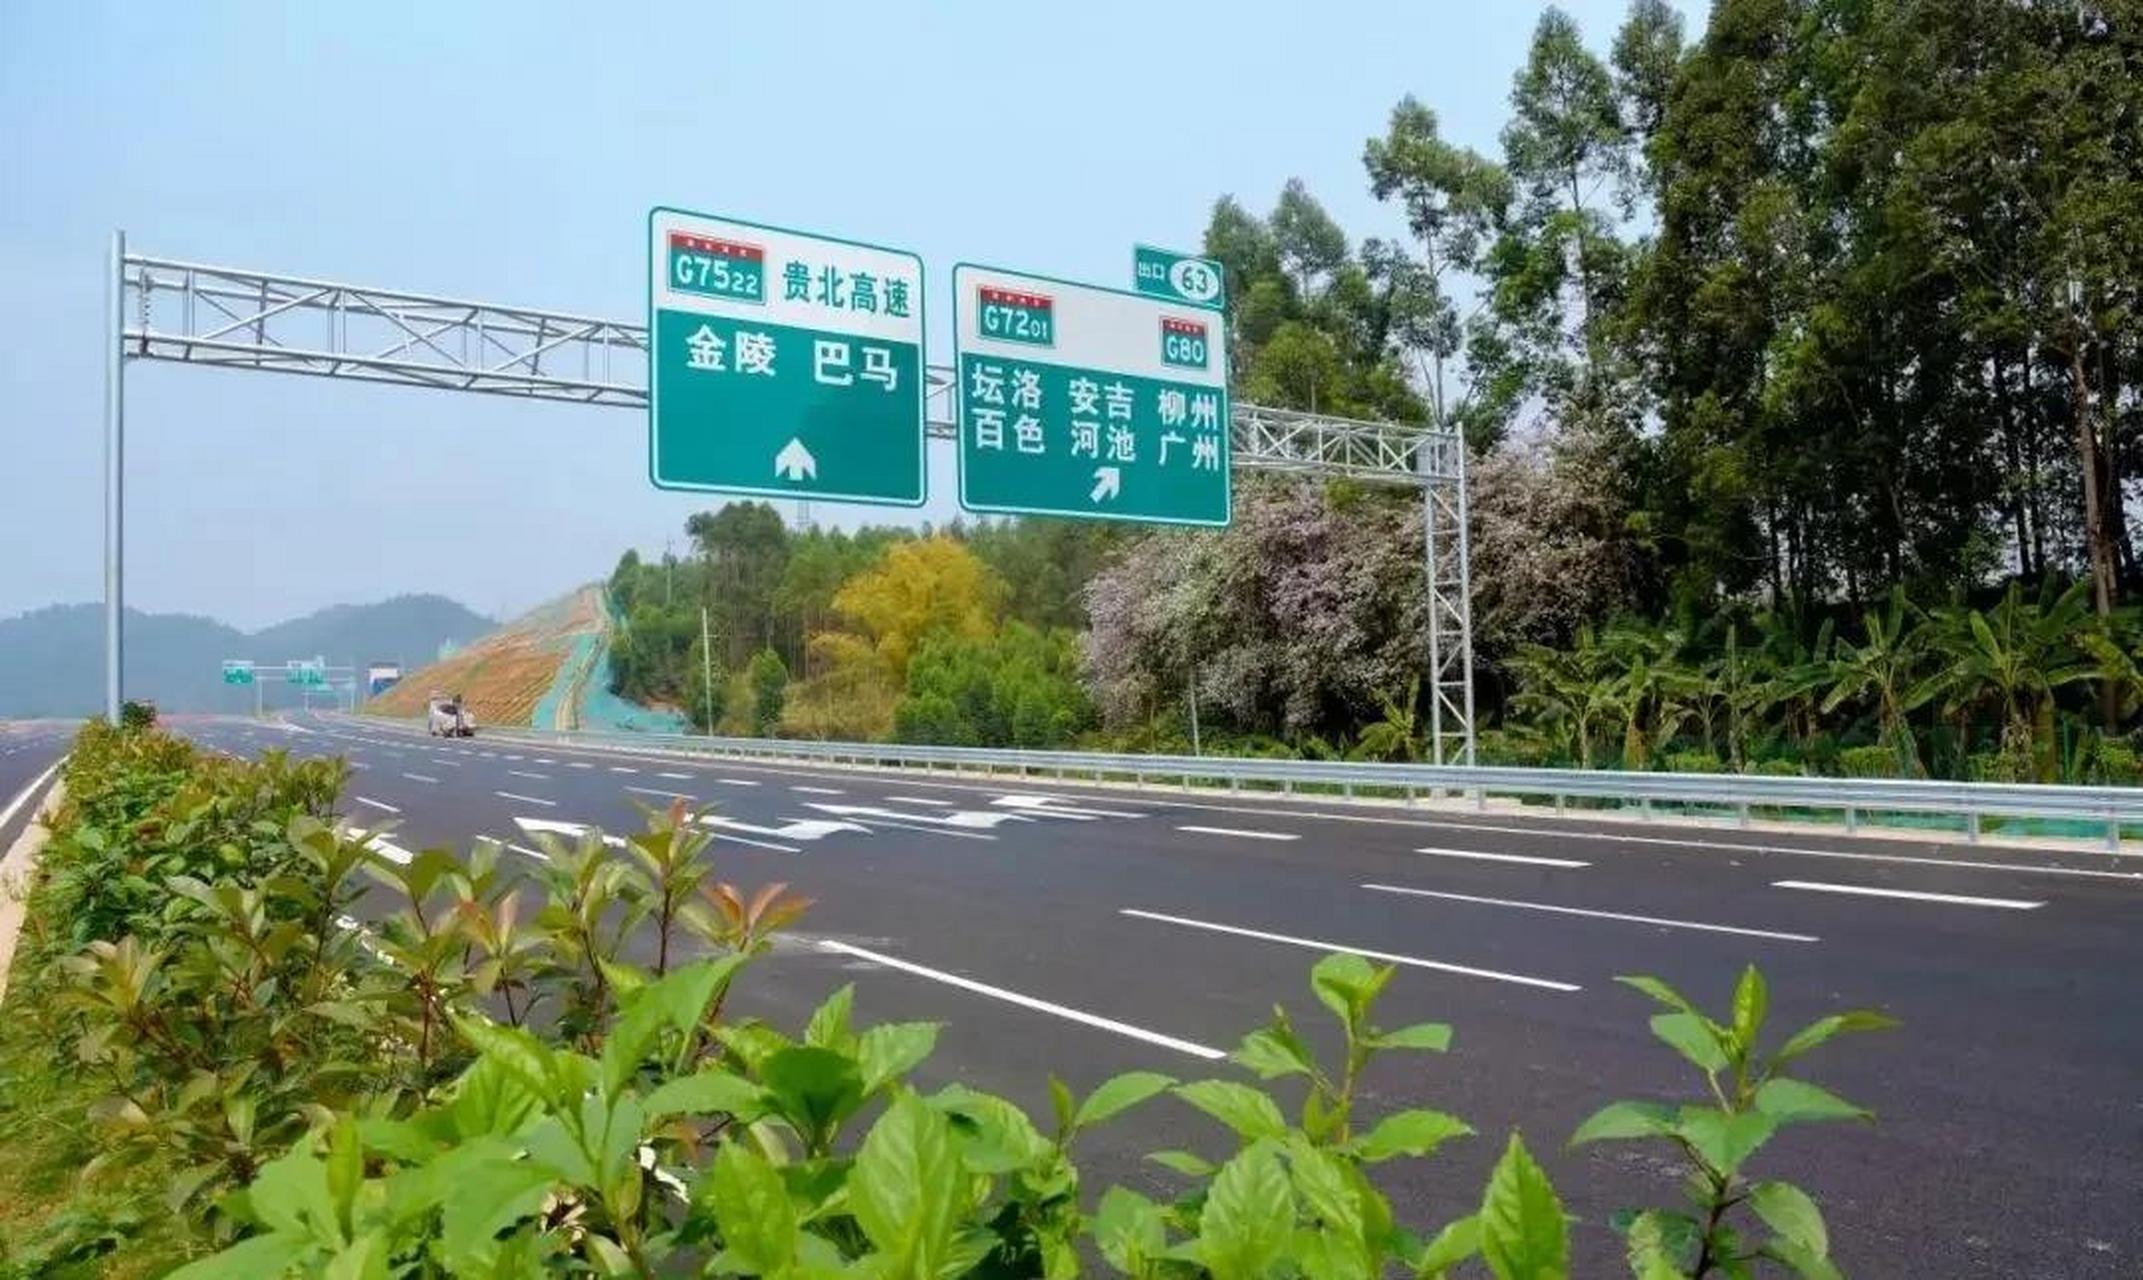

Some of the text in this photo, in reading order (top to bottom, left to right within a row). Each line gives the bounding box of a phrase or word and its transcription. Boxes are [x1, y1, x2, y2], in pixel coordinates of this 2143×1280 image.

[676, 255, 758, 295] G7522
[782, 260, 910, 318] 贵北高速
[1138, 261, 1166, 280] 出口
[1181, 266, 1209, 292] 63
[984, 308, 1048, 339] G7201
[686, 324, 898, 392] 金陵 巴马
[1167, 337, 1204, 362] G80
[972, 362, 1218, 430] 坛洛 安吉 柳州
[972, 408, 1219, 472] 百色 河池 广州
